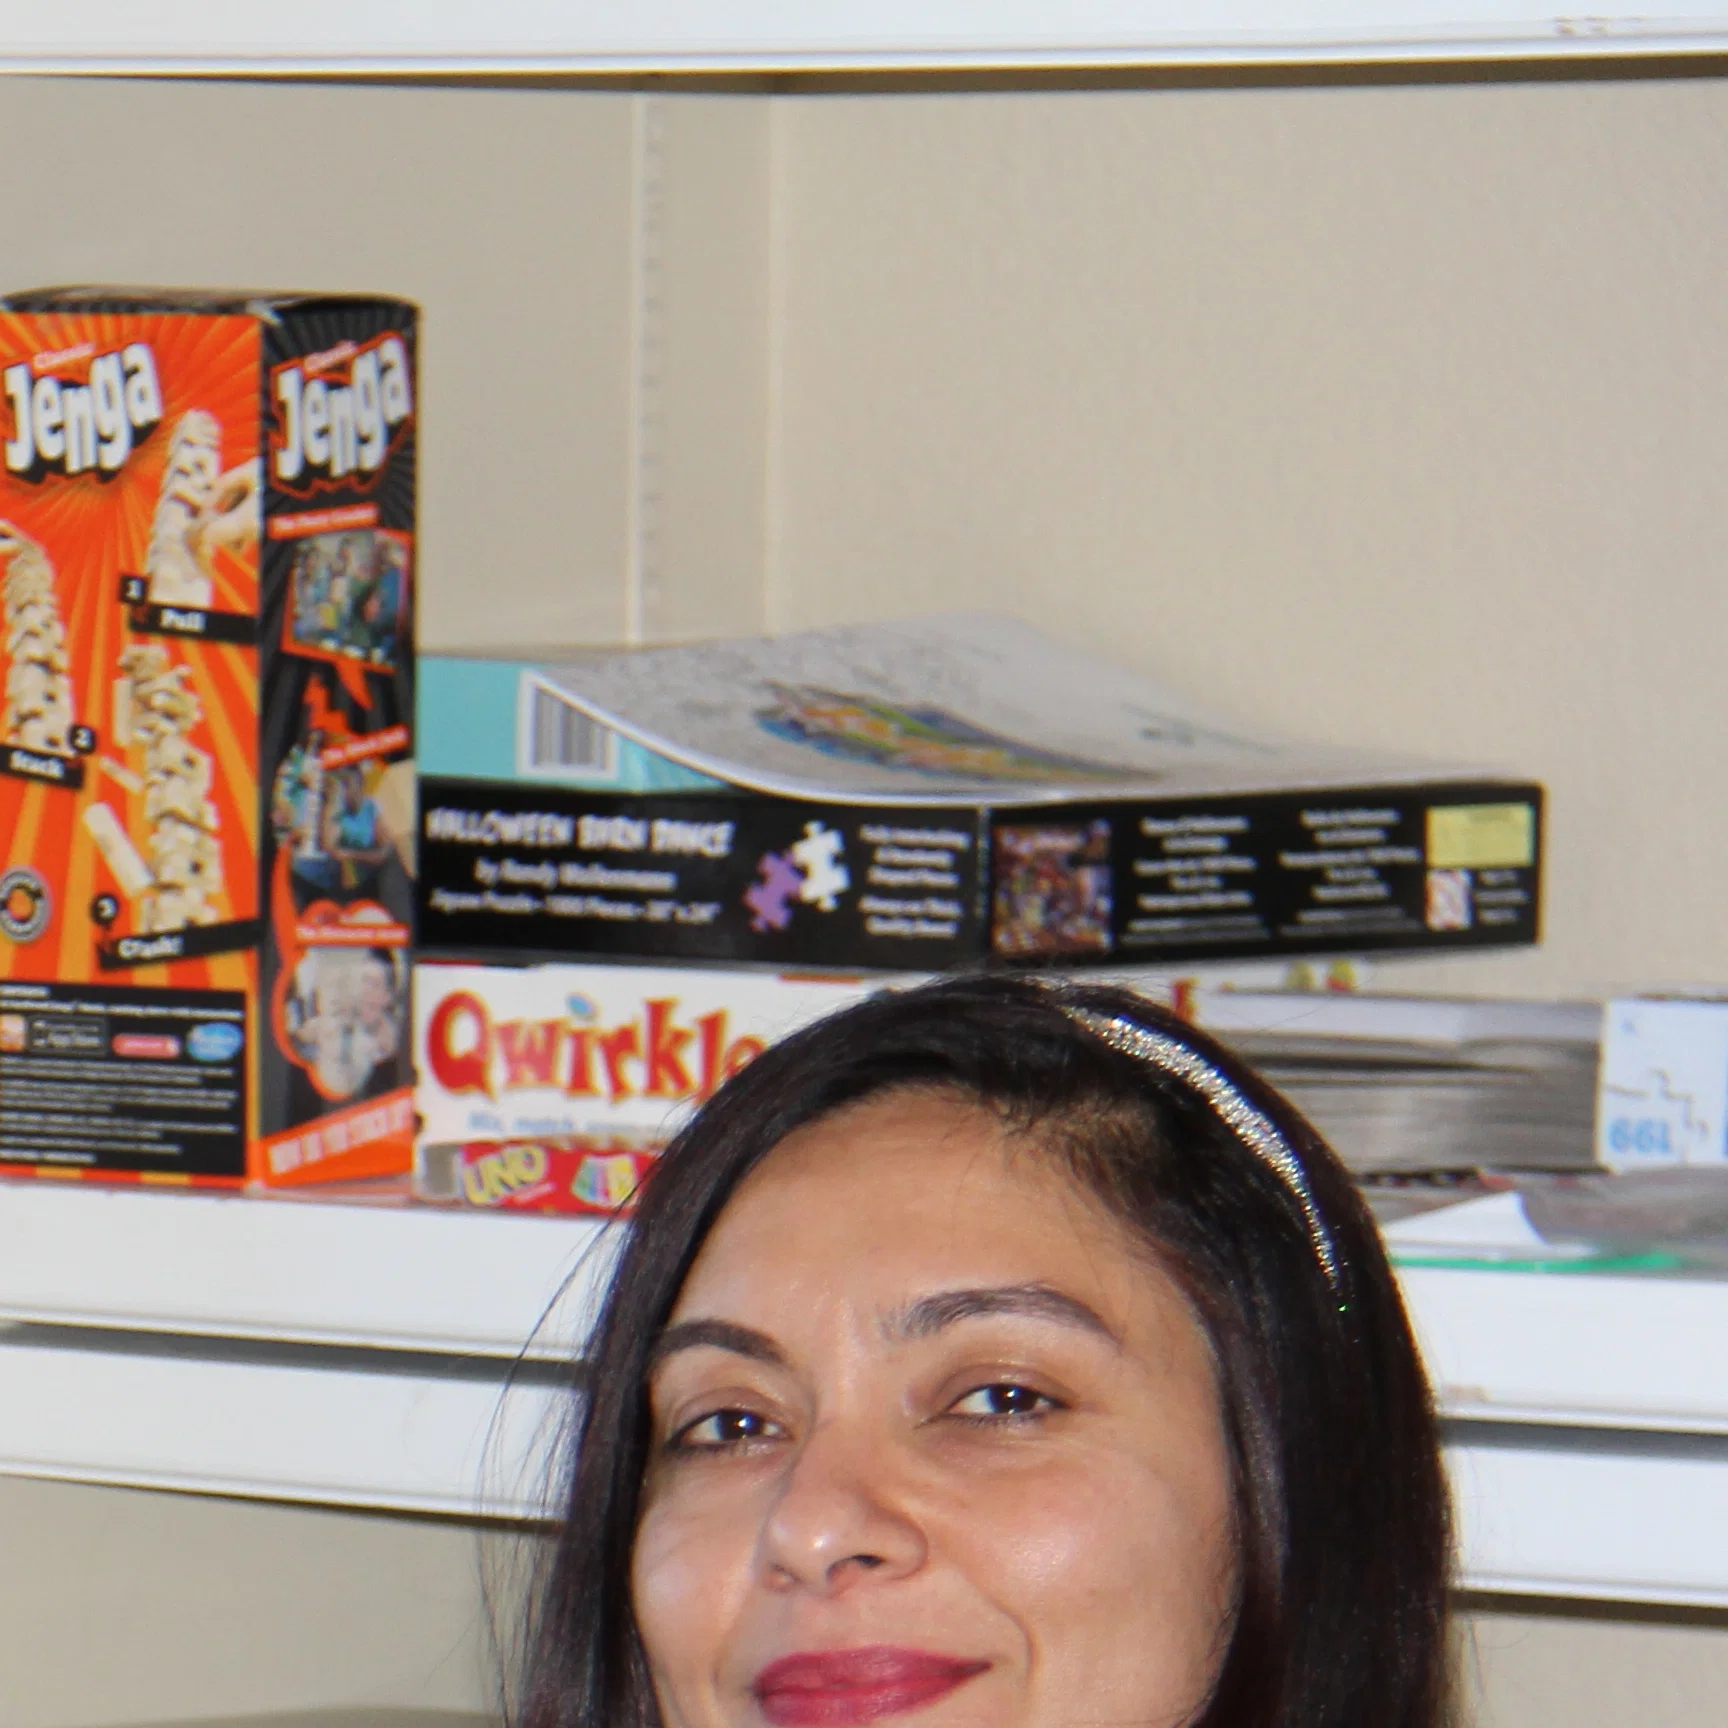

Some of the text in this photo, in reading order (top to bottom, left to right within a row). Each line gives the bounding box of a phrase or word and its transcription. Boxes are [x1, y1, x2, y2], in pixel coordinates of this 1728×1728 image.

[4, 342, 164, 475] Jenga
[277, 338, 413, 480] Jenga
[161, 607, 206, 633] Pull
[10, 750, 65, 779] Stack
[97, 897, 117, 920] 3
[462, 1145, 549, 1206] UNO
